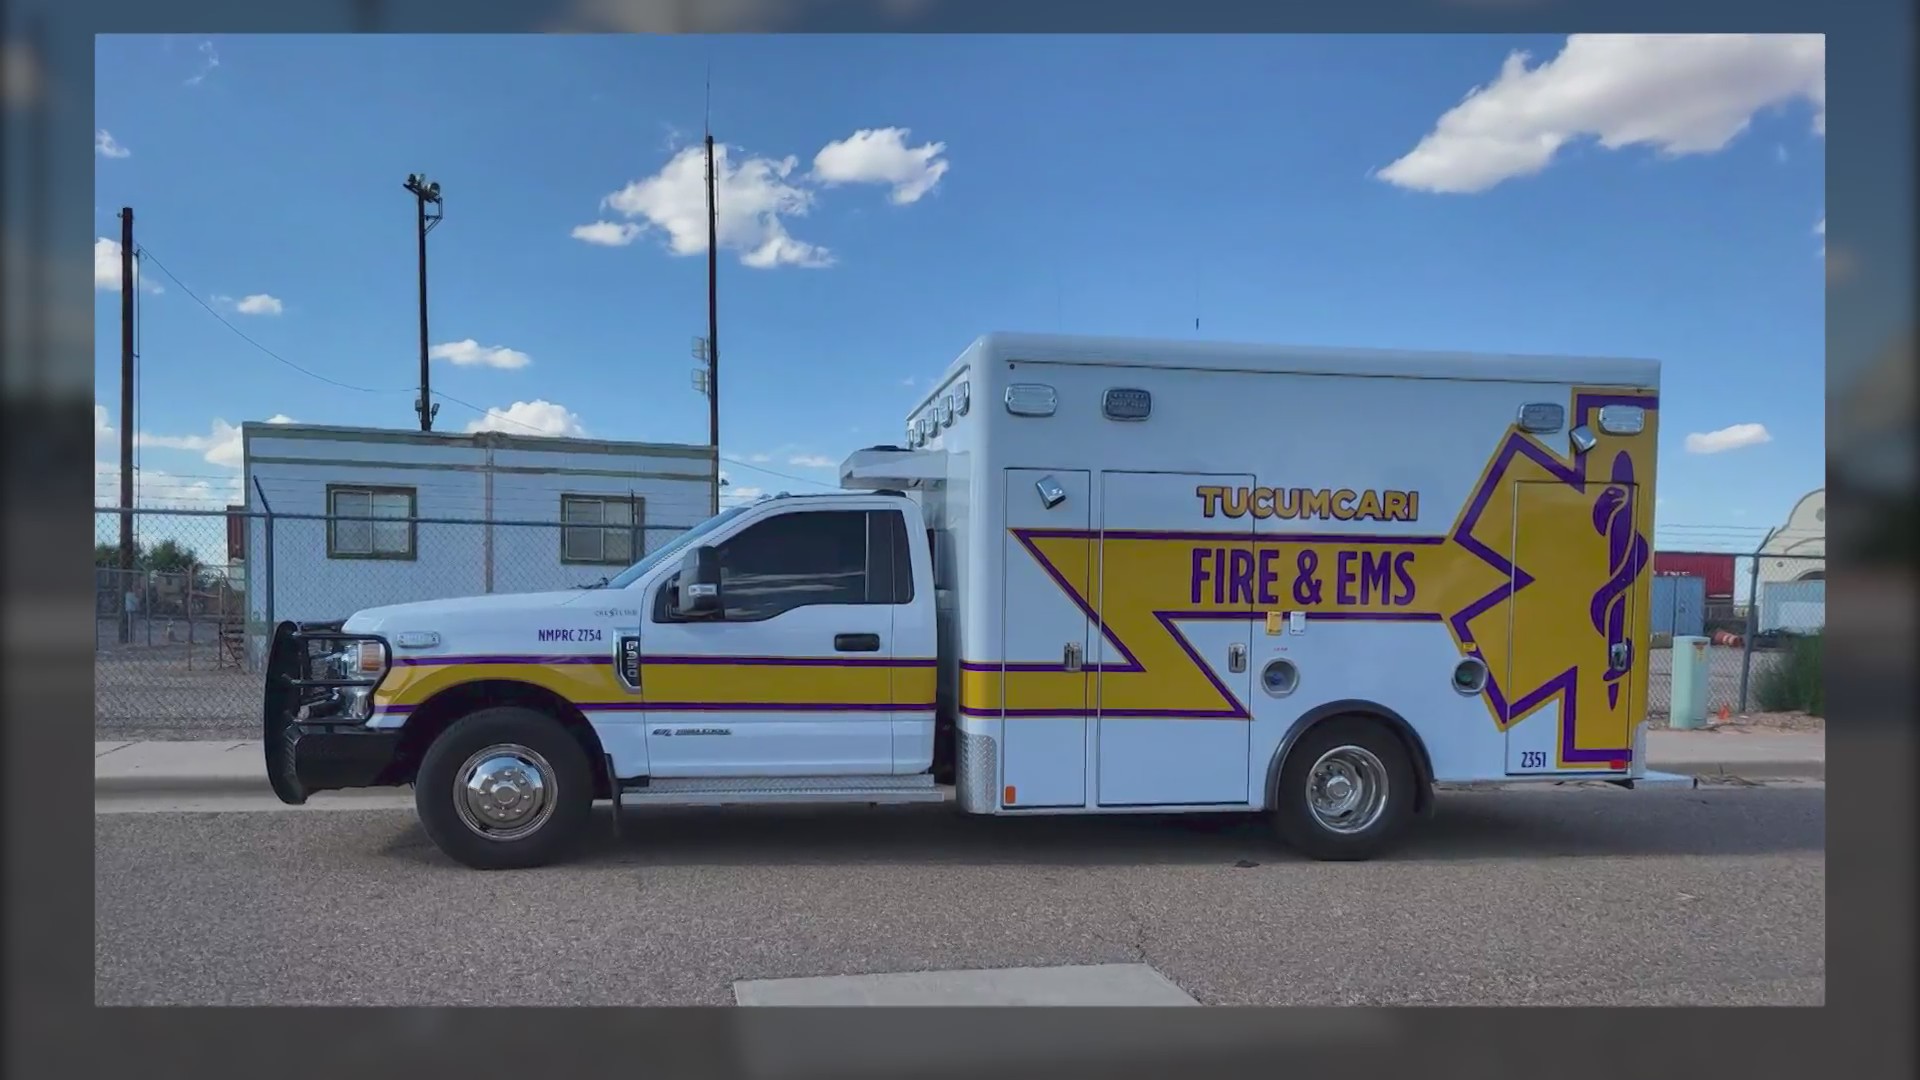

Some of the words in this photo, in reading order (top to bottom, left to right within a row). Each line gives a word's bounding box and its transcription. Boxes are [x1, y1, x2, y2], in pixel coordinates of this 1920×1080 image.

[1196, 486, 1419, 521] TUCUMCARI
[1191, 548, 1280, 604] FIRE
[1292, 549, 1322, 605] &
[1336, 550, 1416, 605] EMS
[538, 629, 575, 642] NMPRC
[577, 629, 602, 642] 2754
[1521, 751, 1546, 768] 2351
